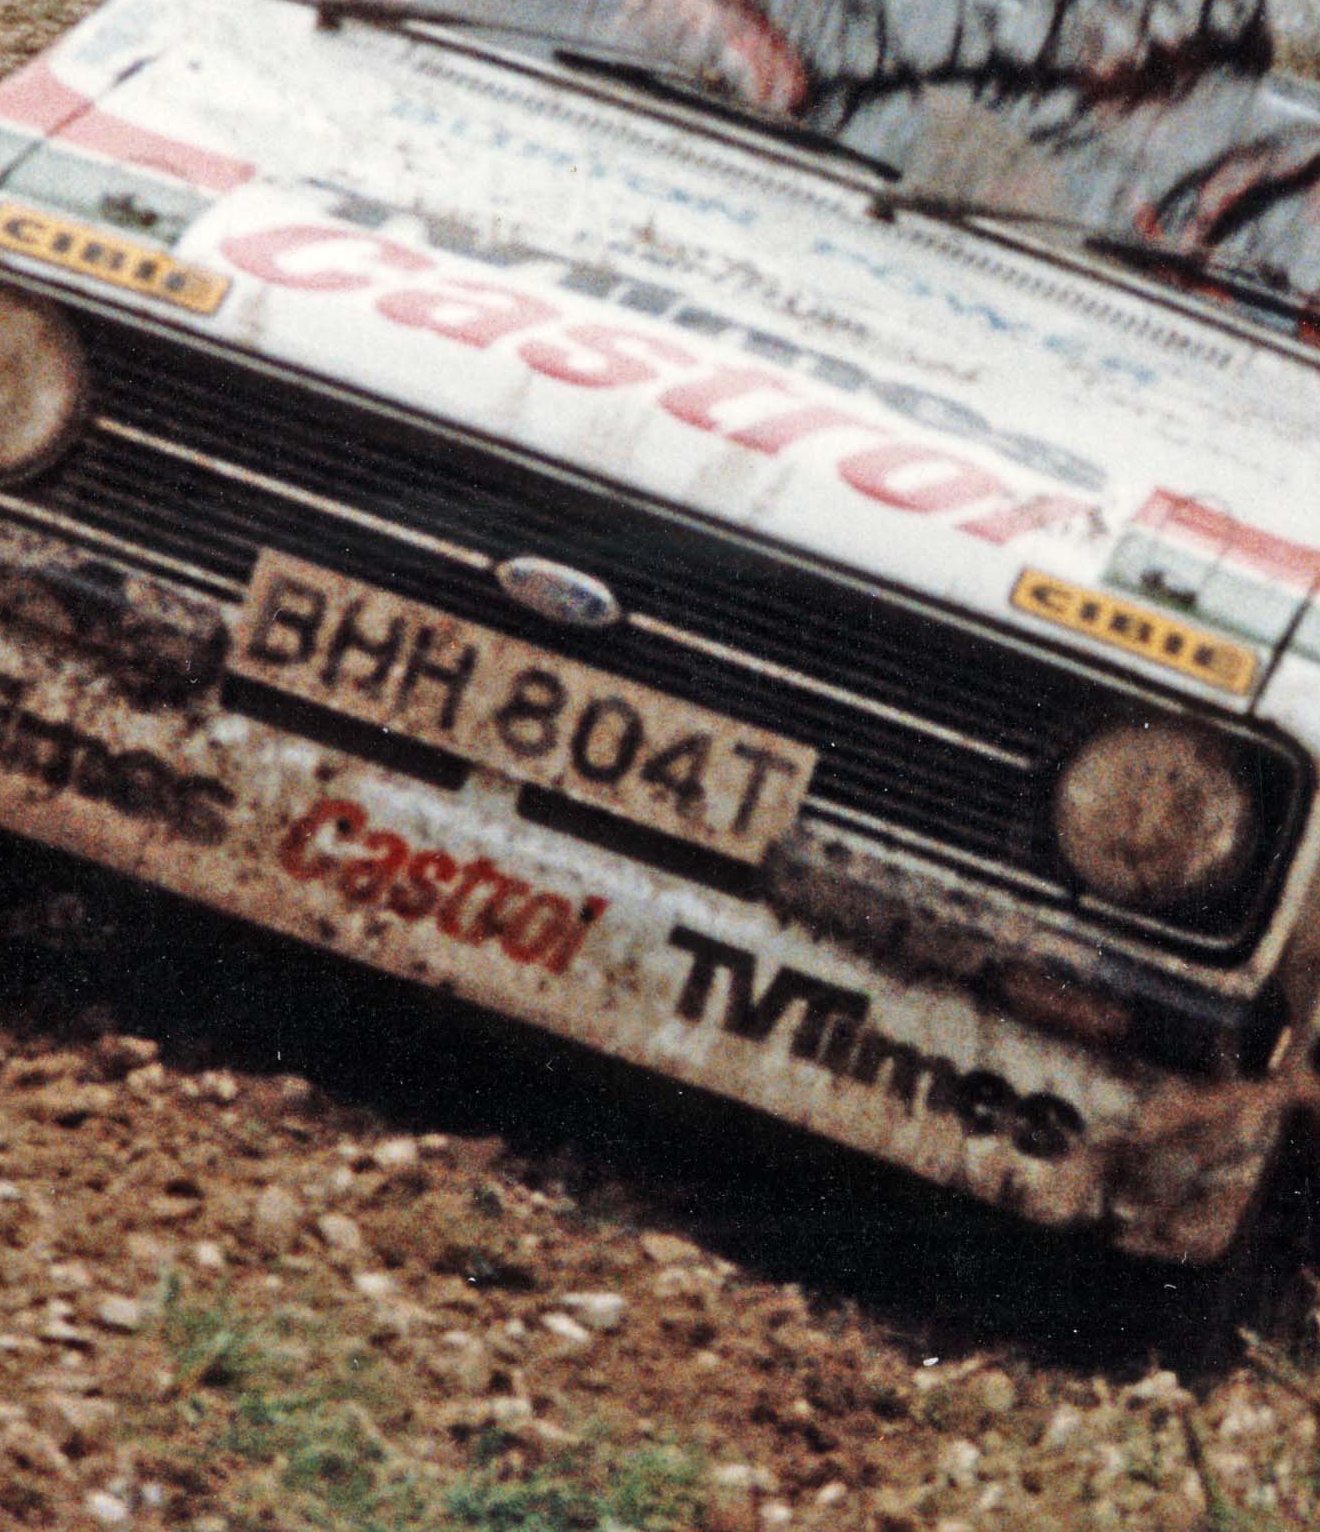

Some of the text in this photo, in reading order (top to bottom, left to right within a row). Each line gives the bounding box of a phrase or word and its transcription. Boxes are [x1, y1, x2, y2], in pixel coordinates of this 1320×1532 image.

[219, 224, 1099, 546] Castrol
[247, 578, 478, 732] BHH
[493, 666, 795, 835] 804T
[282, 799, 609, 970] Castrol
[668, 924, 1084, 1159] TVTimes
